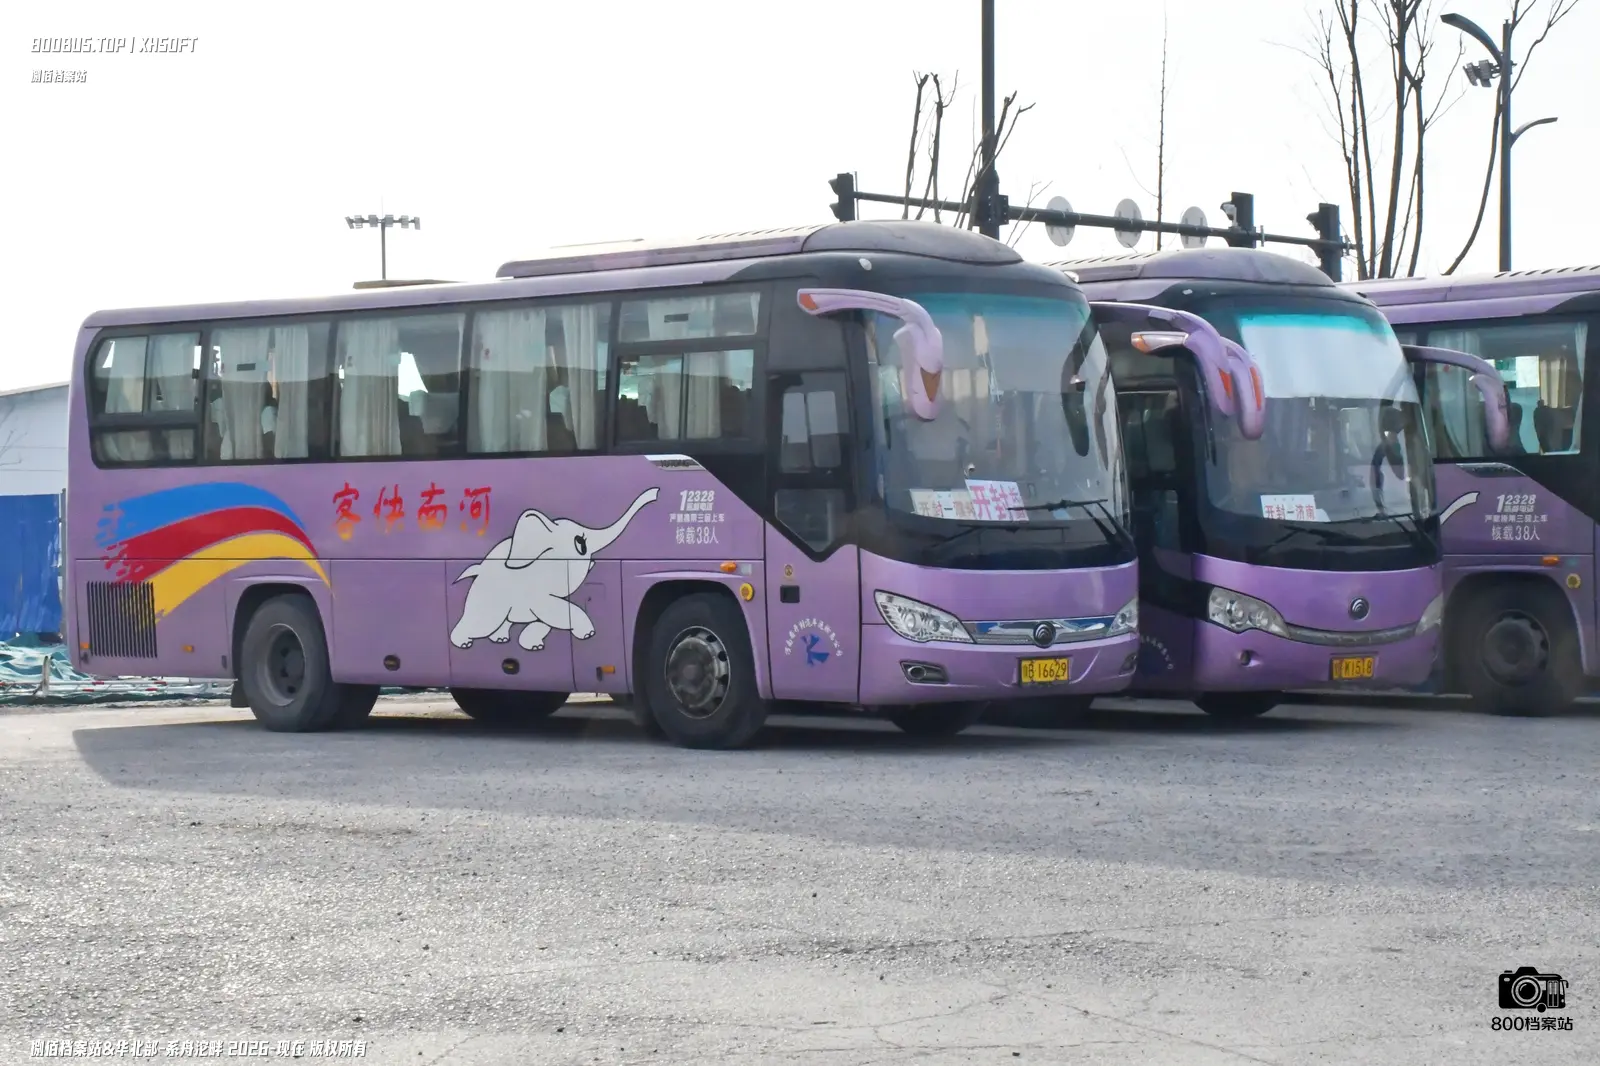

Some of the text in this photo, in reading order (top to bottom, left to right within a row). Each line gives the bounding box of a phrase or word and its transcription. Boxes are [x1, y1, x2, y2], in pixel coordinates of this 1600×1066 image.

[680, 490, 715, 511] 12328
[1497, 494, 1537, 512] 12328
[676, 526, 720, 544] 核载38人
[1491, 524, 1541, 541] 核载38人
